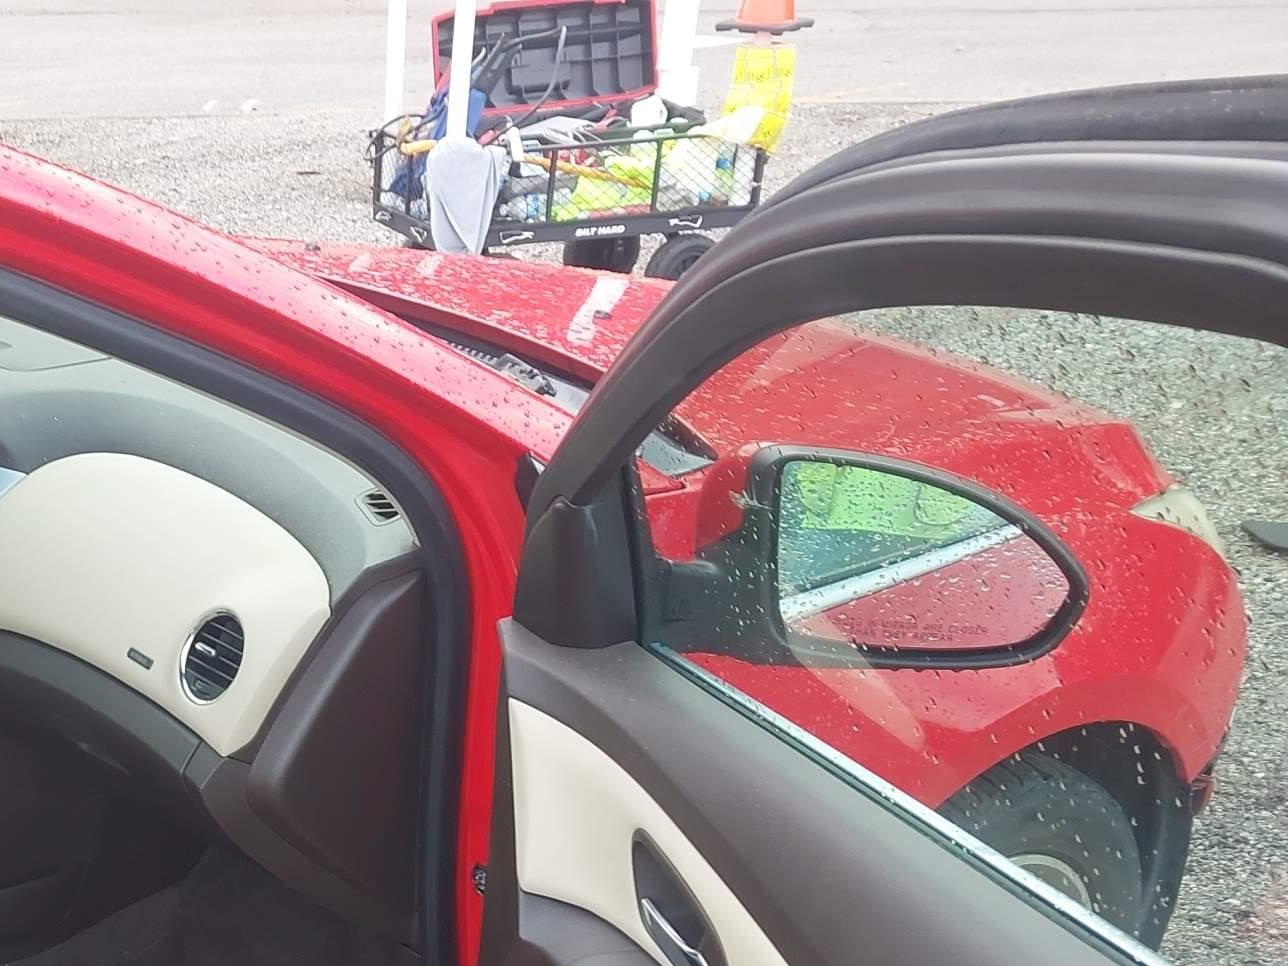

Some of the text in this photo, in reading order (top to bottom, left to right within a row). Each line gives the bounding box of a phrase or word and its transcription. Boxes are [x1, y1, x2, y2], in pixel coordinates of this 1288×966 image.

[575, 224, 626, 237] BILT HARD
[922, 623, 943, 633] ARE
[947, 624, 988, 635] CLOSER
